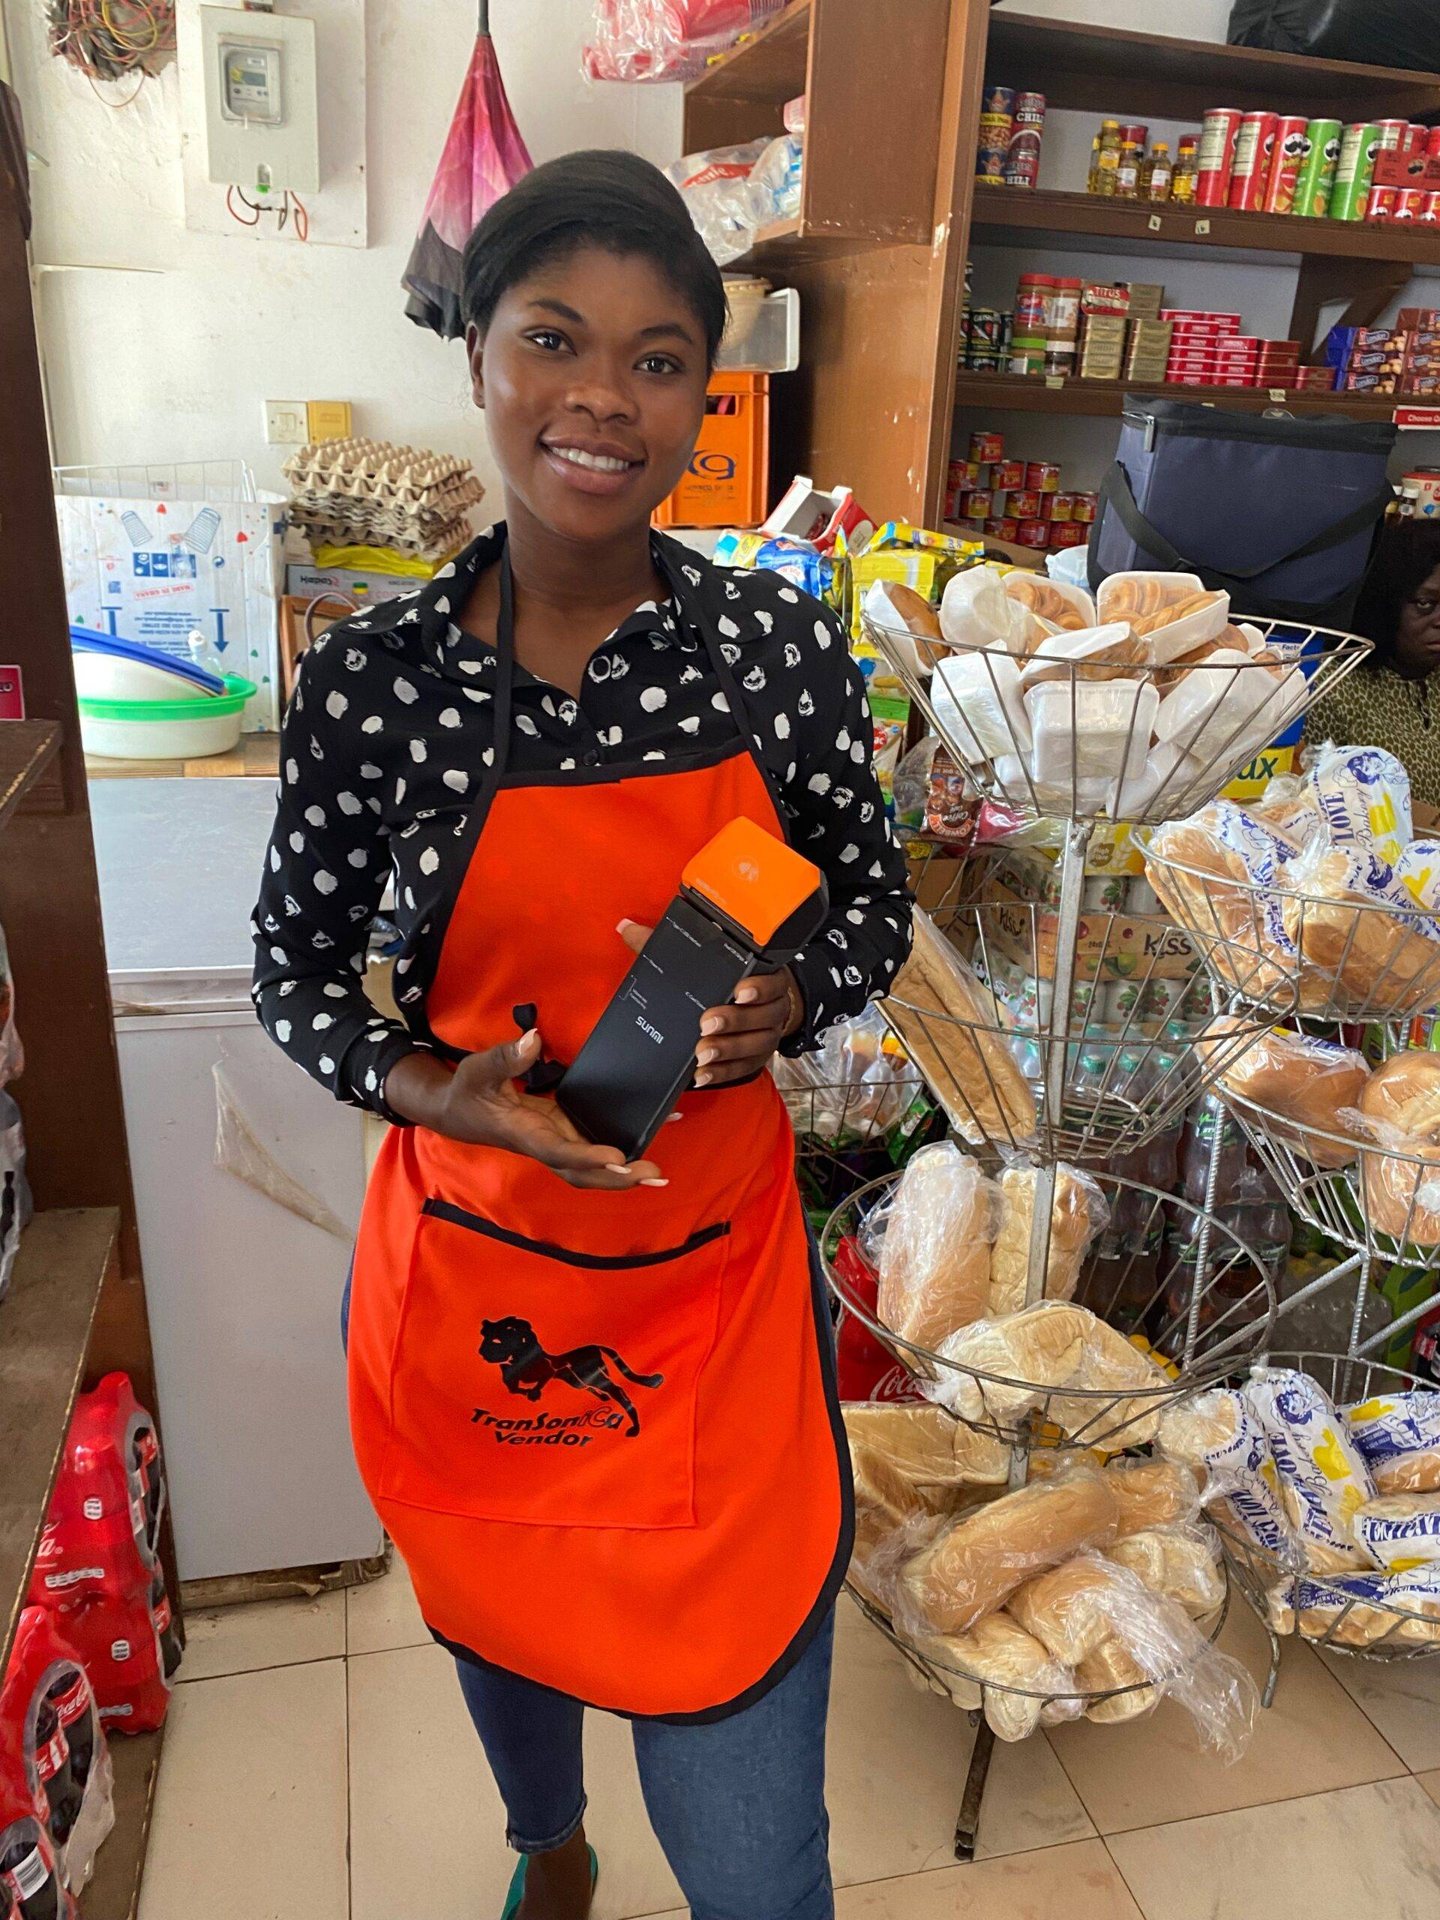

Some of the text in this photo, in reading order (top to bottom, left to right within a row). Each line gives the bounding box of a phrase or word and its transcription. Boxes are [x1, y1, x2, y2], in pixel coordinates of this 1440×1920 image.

[1094, 286, 1121, 299] TITUS
[1324, 791, 1356, 845] LOVE
[495, 1431, 594, 1447] Vendor
